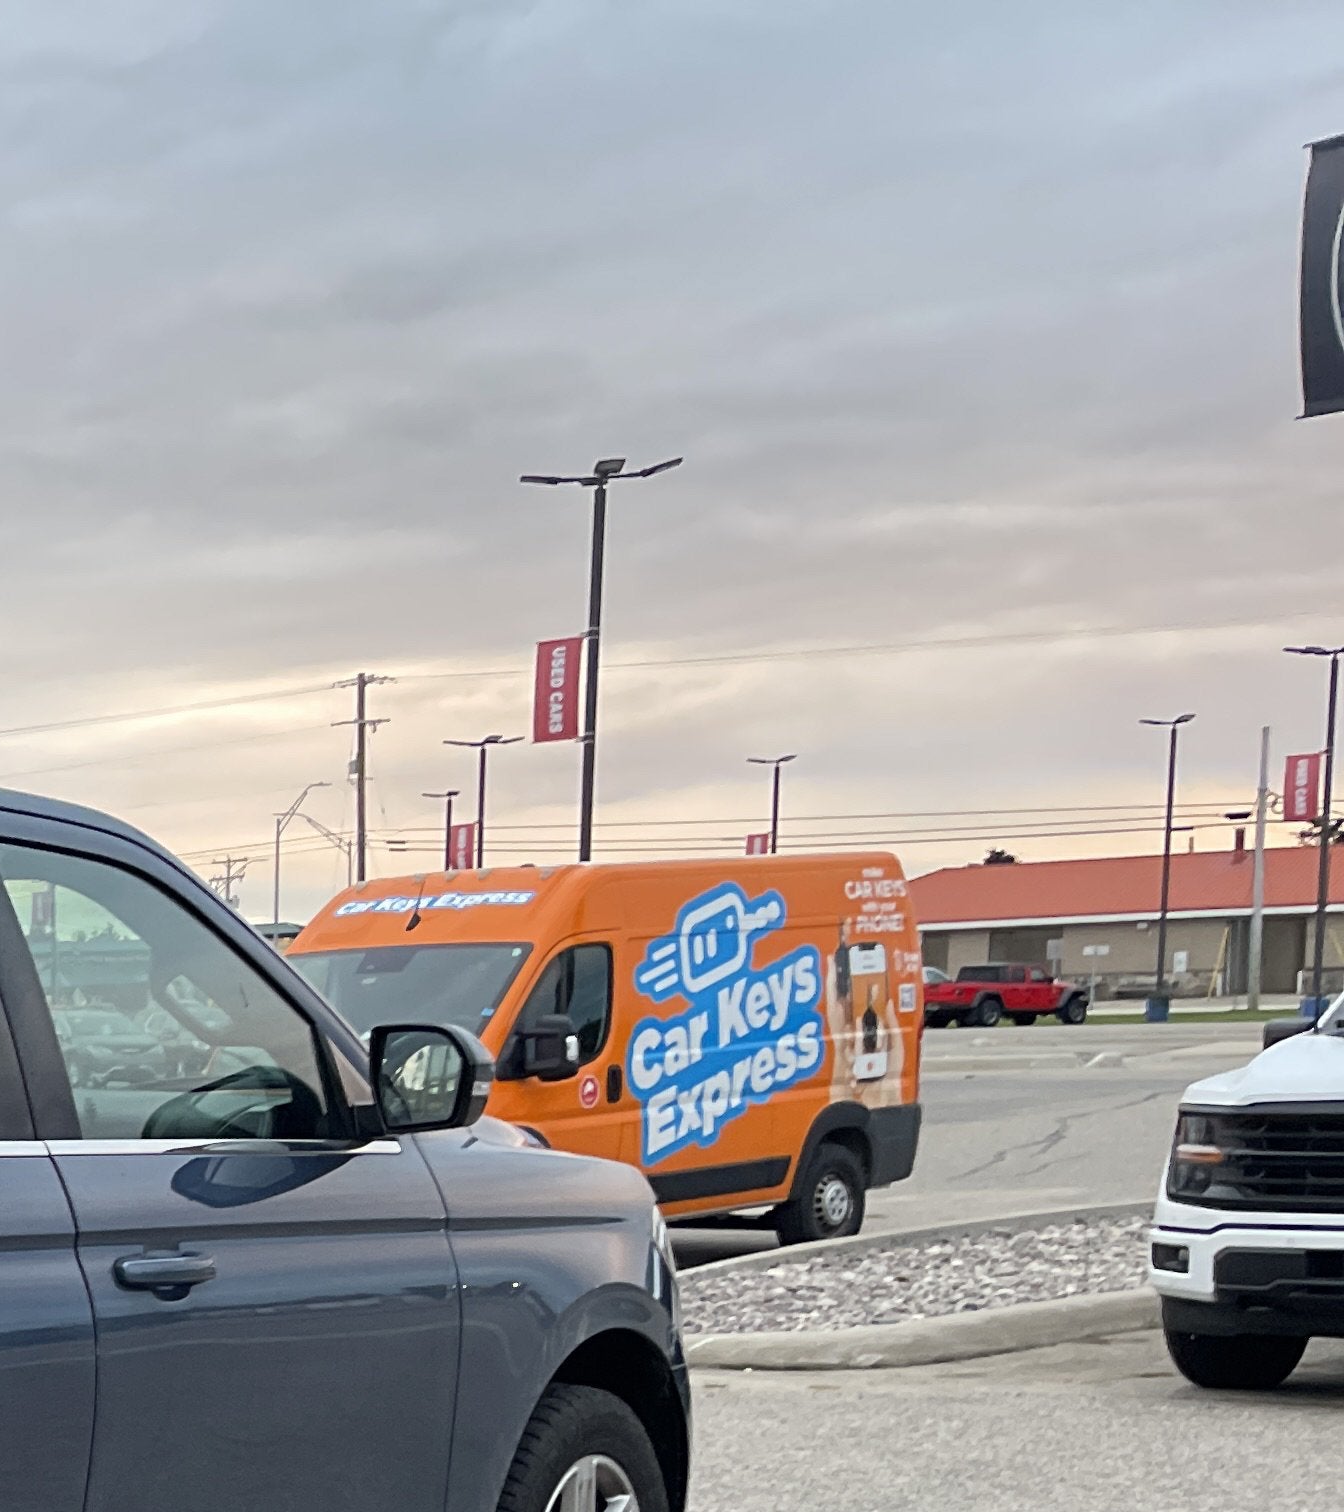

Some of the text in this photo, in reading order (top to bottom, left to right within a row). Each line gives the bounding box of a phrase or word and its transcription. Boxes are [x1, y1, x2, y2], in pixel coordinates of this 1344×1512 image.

[336, 902, 376, 915] Car
[432, 892, 534, 908] Express
[631, 955, 816, 1089] Car Keys
[647, 1021, 819, 1156] Express
